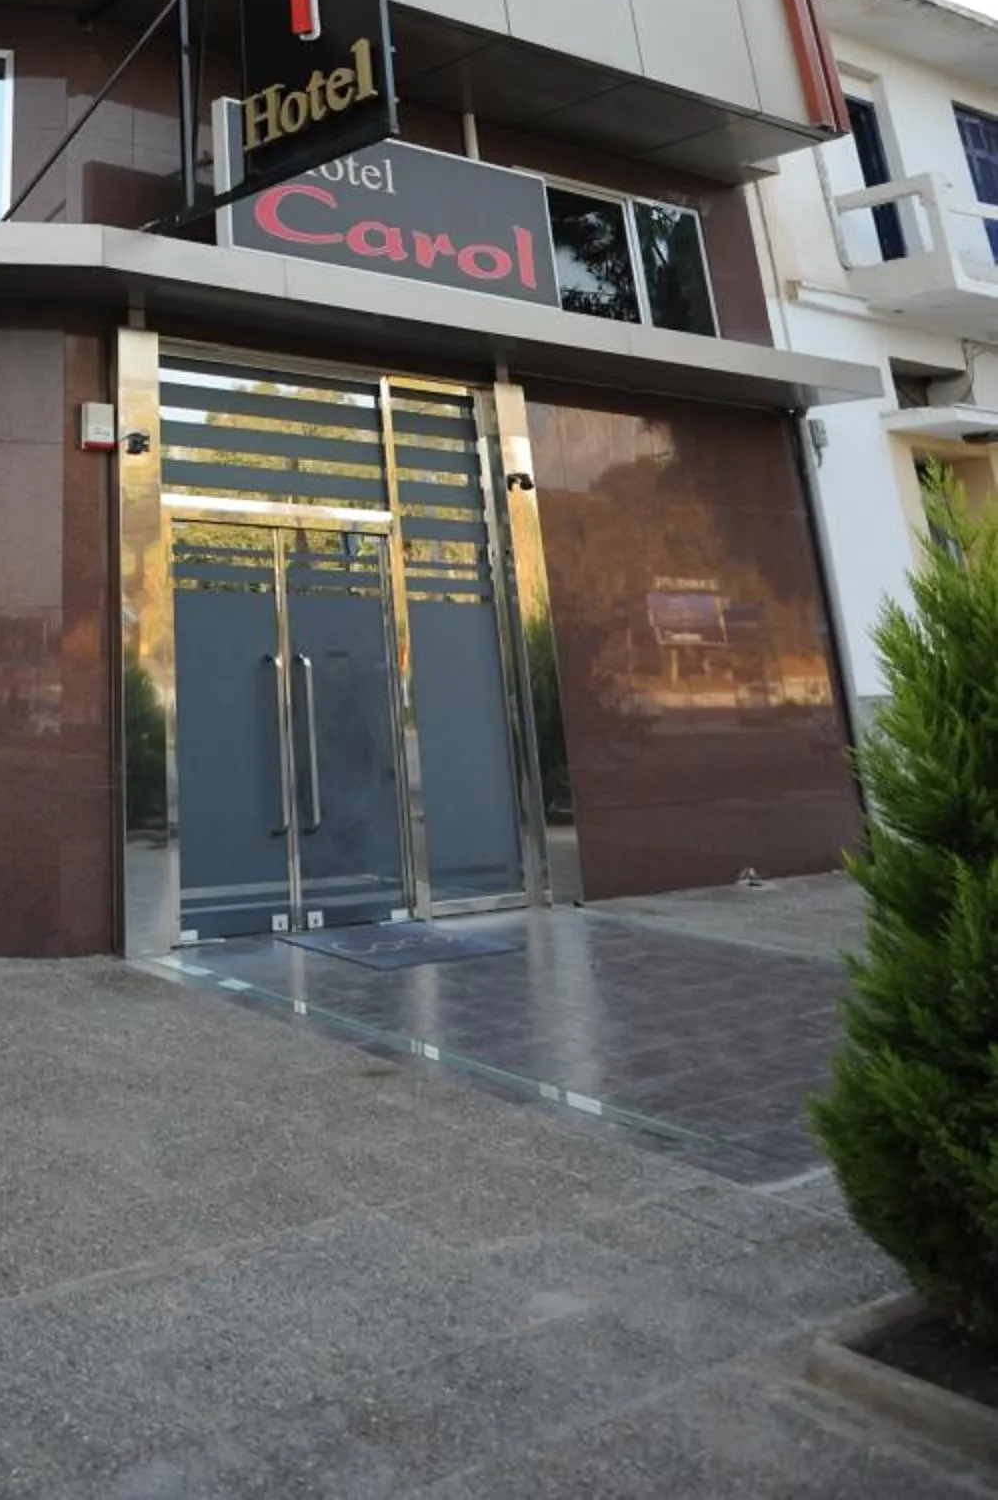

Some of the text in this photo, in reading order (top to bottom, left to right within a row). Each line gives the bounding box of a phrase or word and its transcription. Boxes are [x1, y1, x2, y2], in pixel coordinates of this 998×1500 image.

[241, 37, 378, 151] Hotel
[305, 152, 397, 194] otel
[253, 183, 538, 290] Carol
